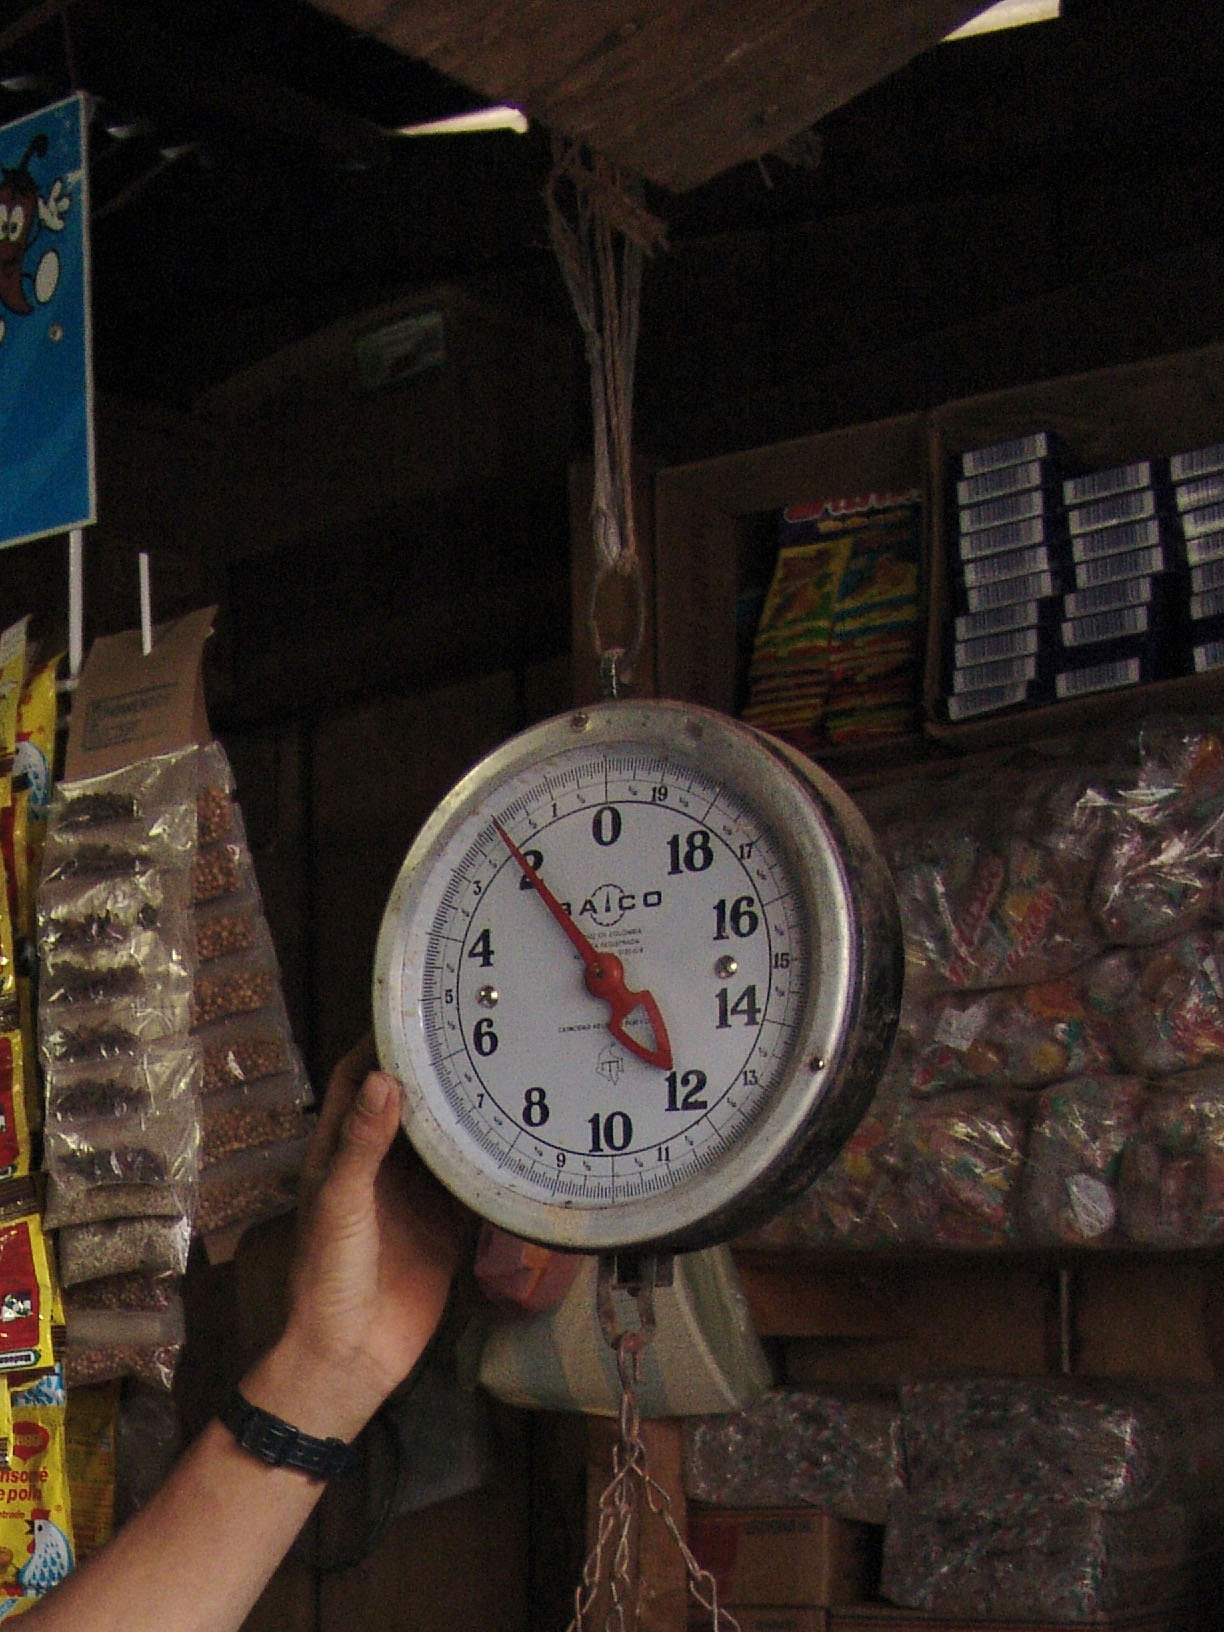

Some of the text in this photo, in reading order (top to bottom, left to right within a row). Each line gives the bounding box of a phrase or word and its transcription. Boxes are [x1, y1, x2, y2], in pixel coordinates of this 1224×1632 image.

[651, 785, 668, 801] 19
[592, 806, 622, 846] 0
[519, 849, 545, 891] 2
[666, 830, 714, 875] 18
[739, 843, 753, 860] 17
[472, 880, 482, 895] 3
[713, 896, 759, 941] 16
[468, 928, 495, 967] 4
[774, 952, 790, 969] 15
[444, 988, 453, 1003] 5
[715, 984, 762, 1029] 14
[472, 1018, 498, 1057] 6
[664, 1069, 708, 1112] 12
[742, 1070, 758, 1086] 13
[476, 1093, 485, 1108] 7
[522, 1087, 550, 1127] 8
[588, 1111, 633, 1153] 10
[556, 1152, 566, 1168] 9
[656, 1147, 671, 1162] 11
